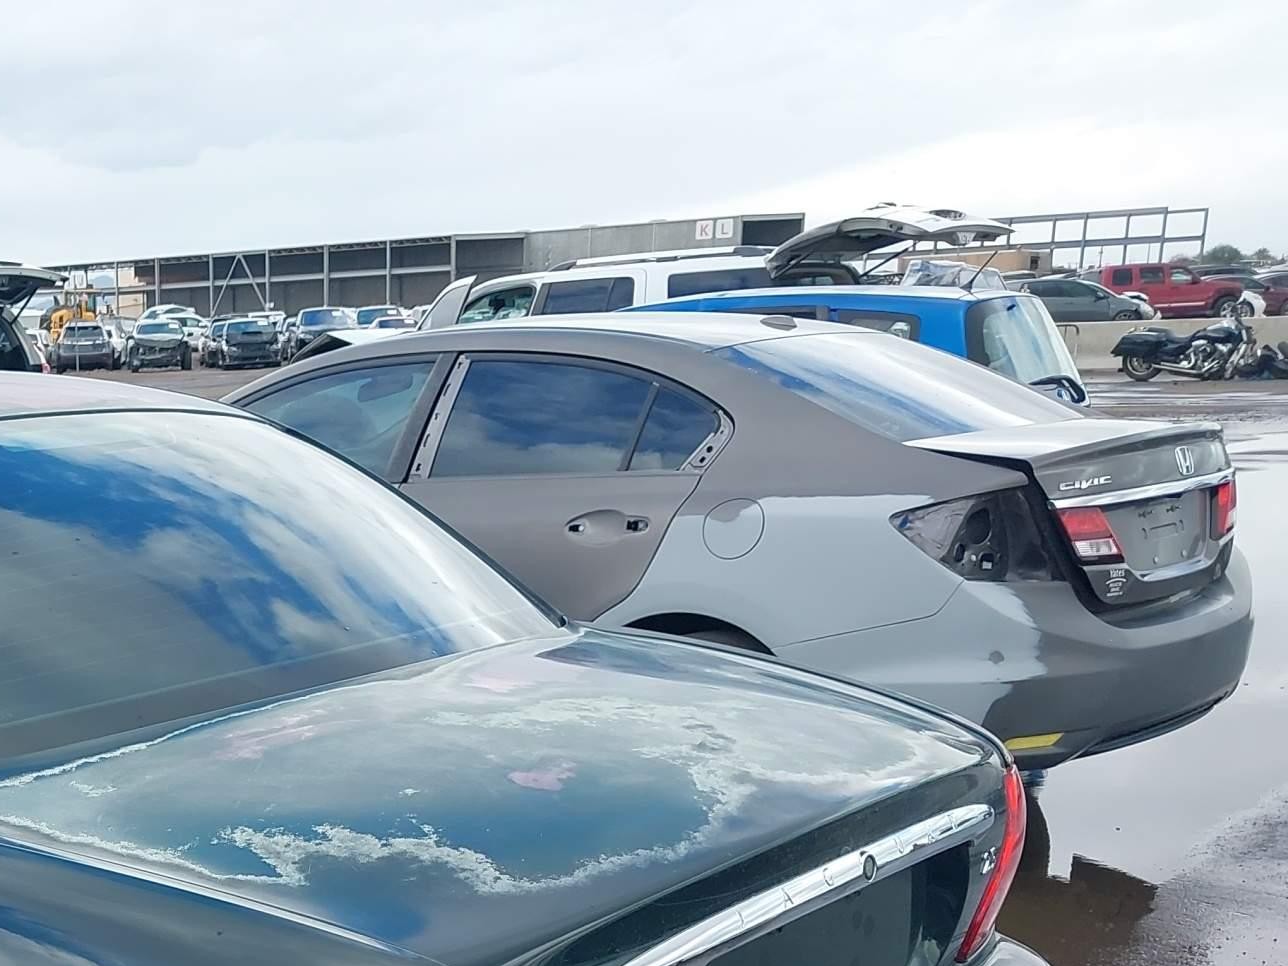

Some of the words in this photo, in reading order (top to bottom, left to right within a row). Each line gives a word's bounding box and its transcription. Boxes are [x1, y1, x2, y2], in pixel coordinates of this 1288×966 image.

[700, 223, 710, 237] K
[721, 223, 728, 235] L
[1059, 475, 1112, 491] CIVIC
